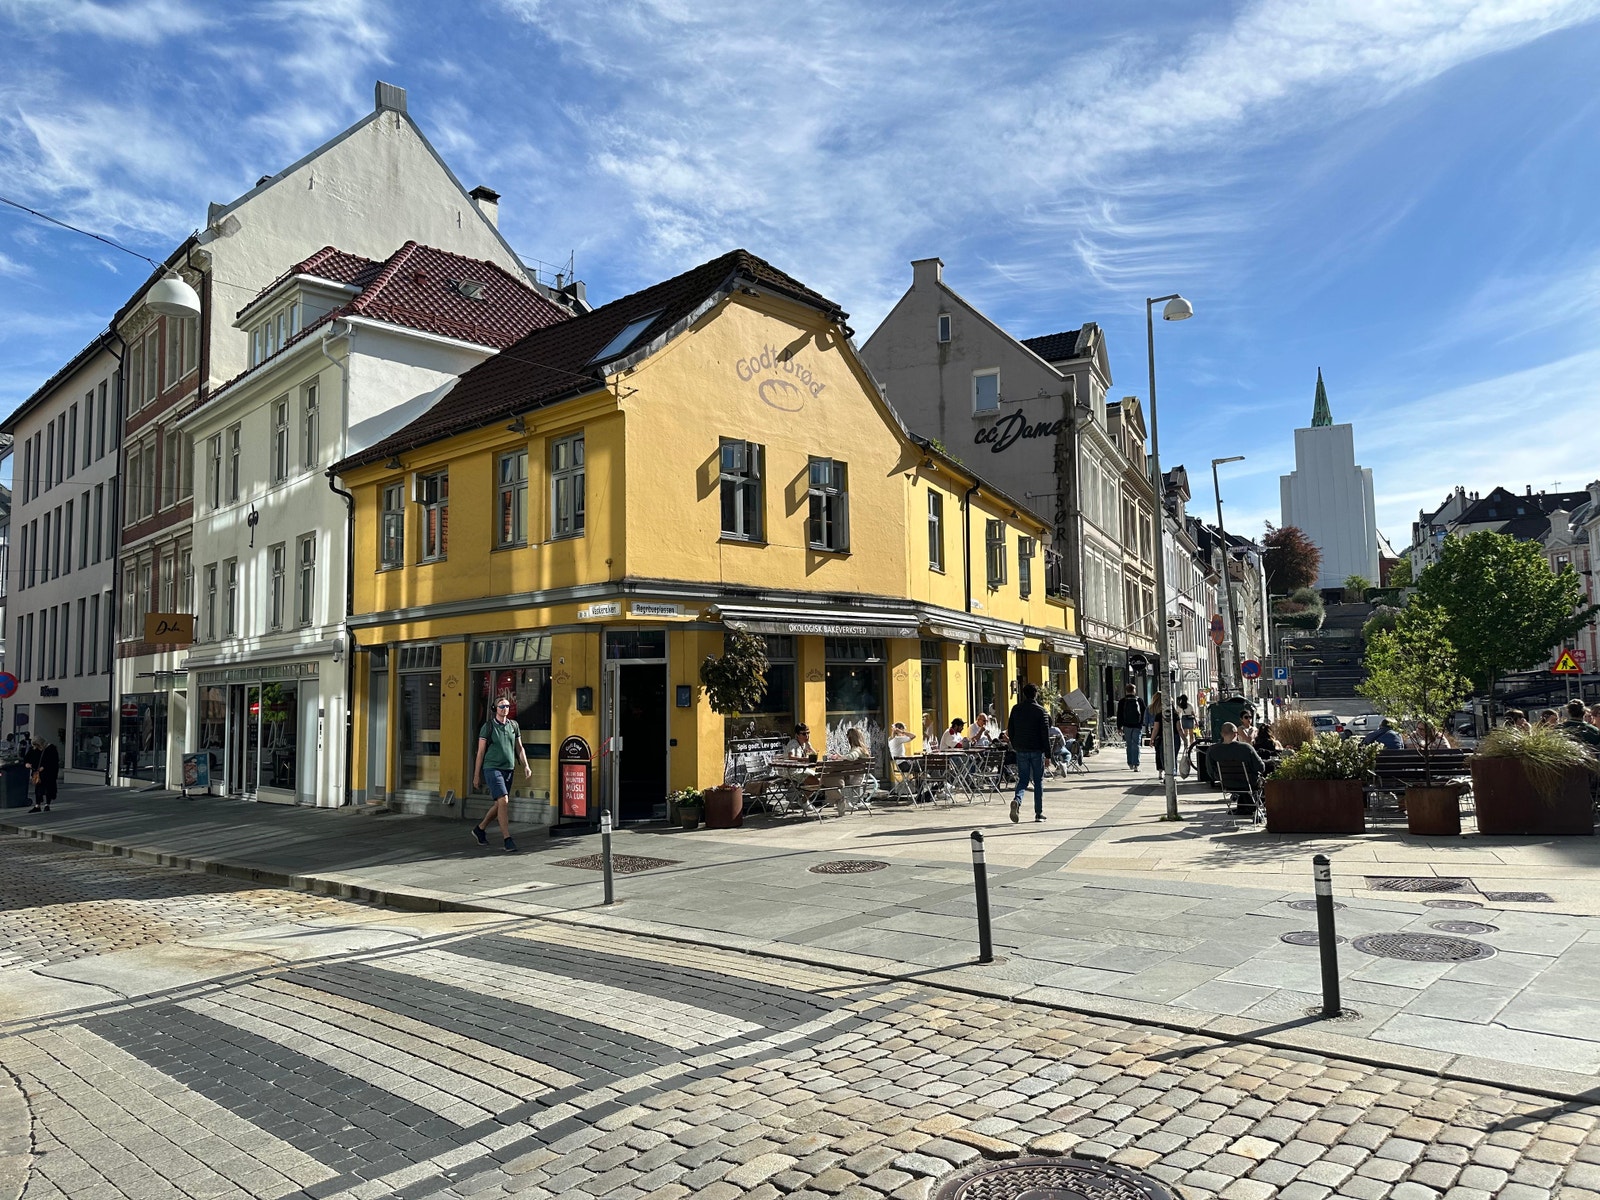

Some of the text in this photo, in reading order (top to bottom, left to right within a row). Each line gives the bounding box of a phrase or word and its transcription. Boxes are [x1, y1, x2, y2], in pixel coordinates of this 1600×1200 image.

[736, 343, 826, 399] Godt Brød
[1052, 443, 1067, 542] FRISØR
[788, 624, 867, 635] ØKOLOGISK BAKEVERKSTED
[1277, 669, 1285, 678] P
[737, 744, 747, 752] Spis
[566, 783, 584, 792] MÜSLI
[573, 792, 584, 800] LUR
